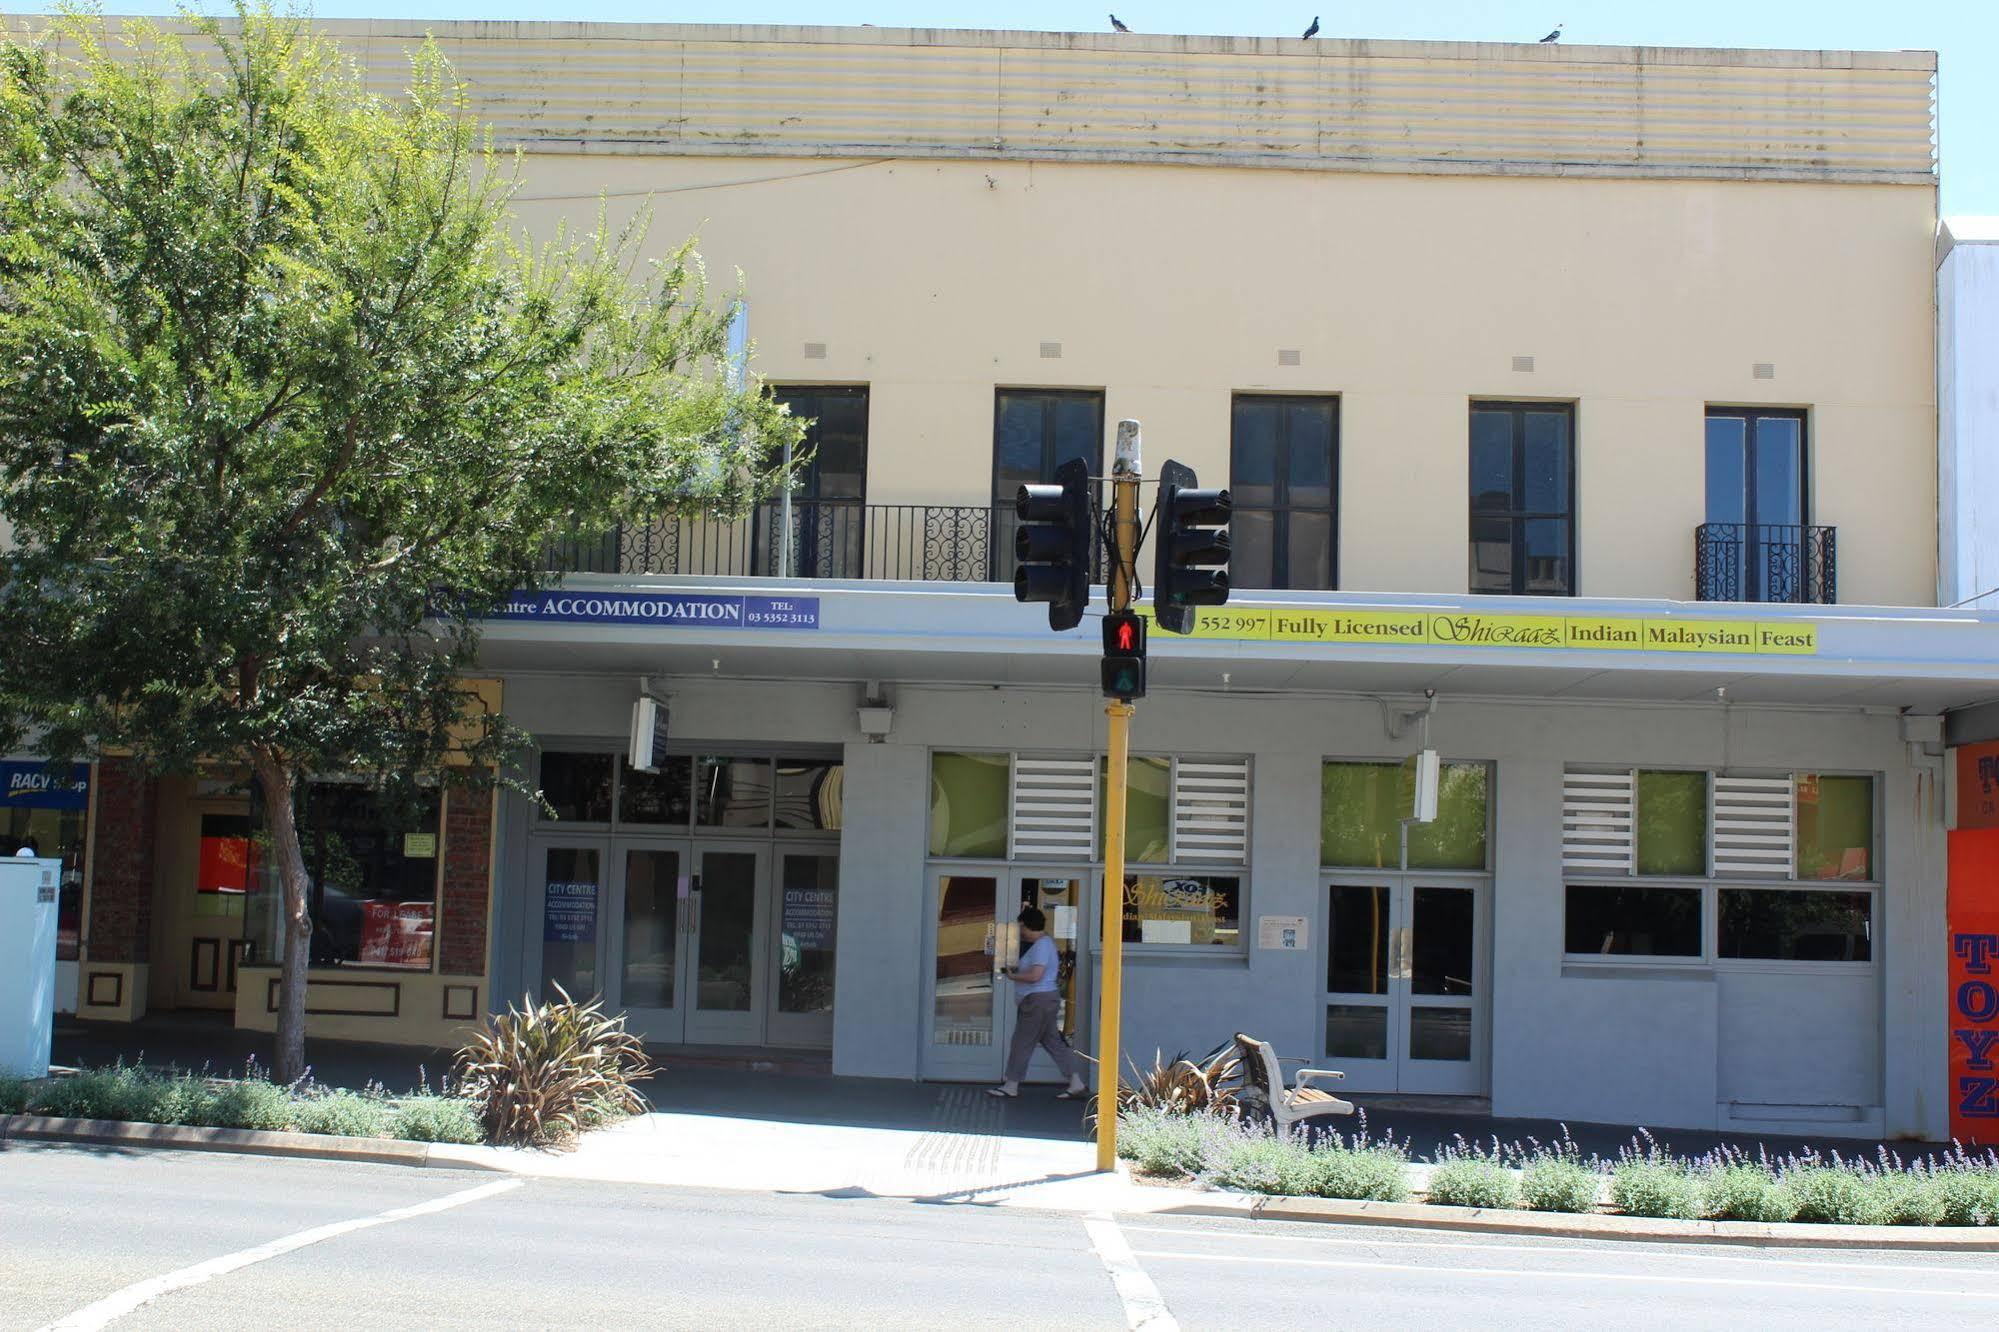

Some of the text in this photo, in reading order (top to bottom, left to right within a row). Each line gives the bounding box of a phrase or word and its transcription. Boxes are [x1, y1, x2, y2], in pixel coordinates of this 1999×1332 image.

[542, 598, 741, 620] ACCOMMODATION
[770, 601, 794, 612] TEL:
[748, 613, 815, 625] 03 5352 3113
[1201, 616, 1266, 632] 552 997
[1277, 617, 1424, 638] Fully Licensed
[1571, 625, 1638, 643] Indian
[1648, 626, 1751, 648] Malaysian
[1761, 630, 1814, 647] Feast
[10, 772, 50, 789] RACV
[548, 883, 597, 896] CITY CENTRE
[1953, 933, 1999, 1119] TOYZ
